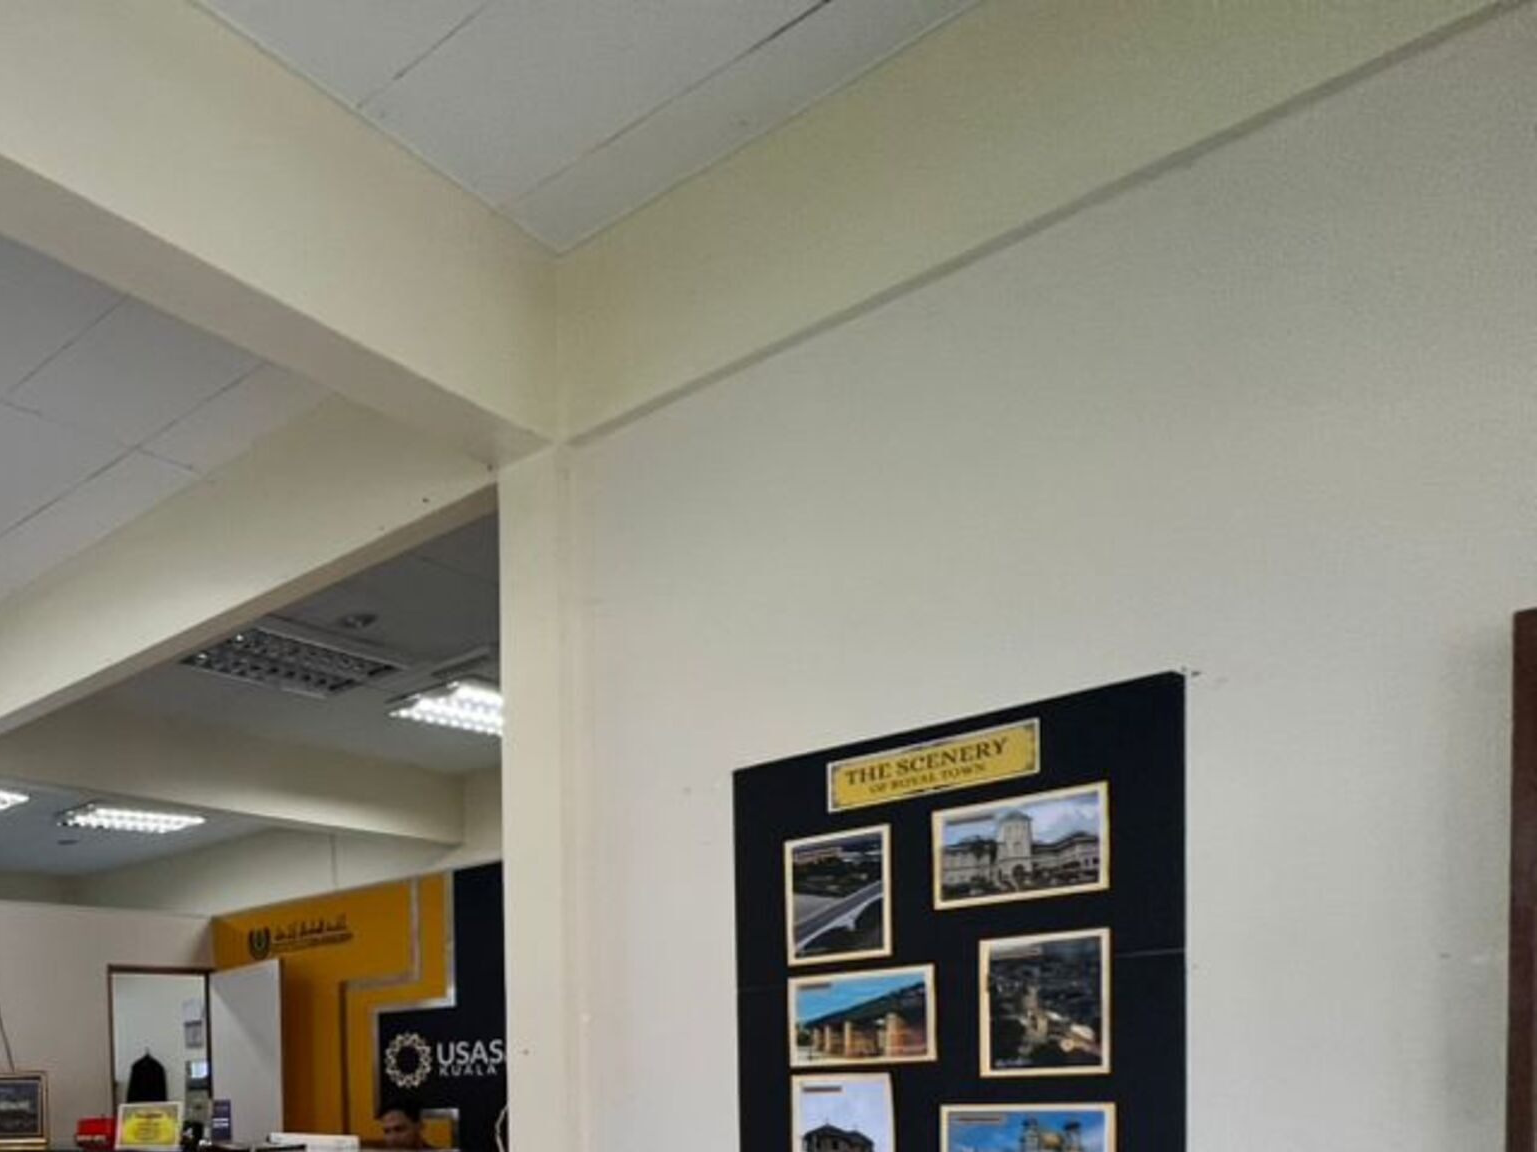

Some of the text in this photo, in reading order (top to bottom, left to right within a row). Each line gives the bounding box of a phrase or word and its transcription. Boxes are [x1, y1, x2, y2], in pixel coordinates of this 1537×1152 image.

[844, 737, 1008, 785] THE SCENERY
[436, 1039, 504, 1065] USAS
